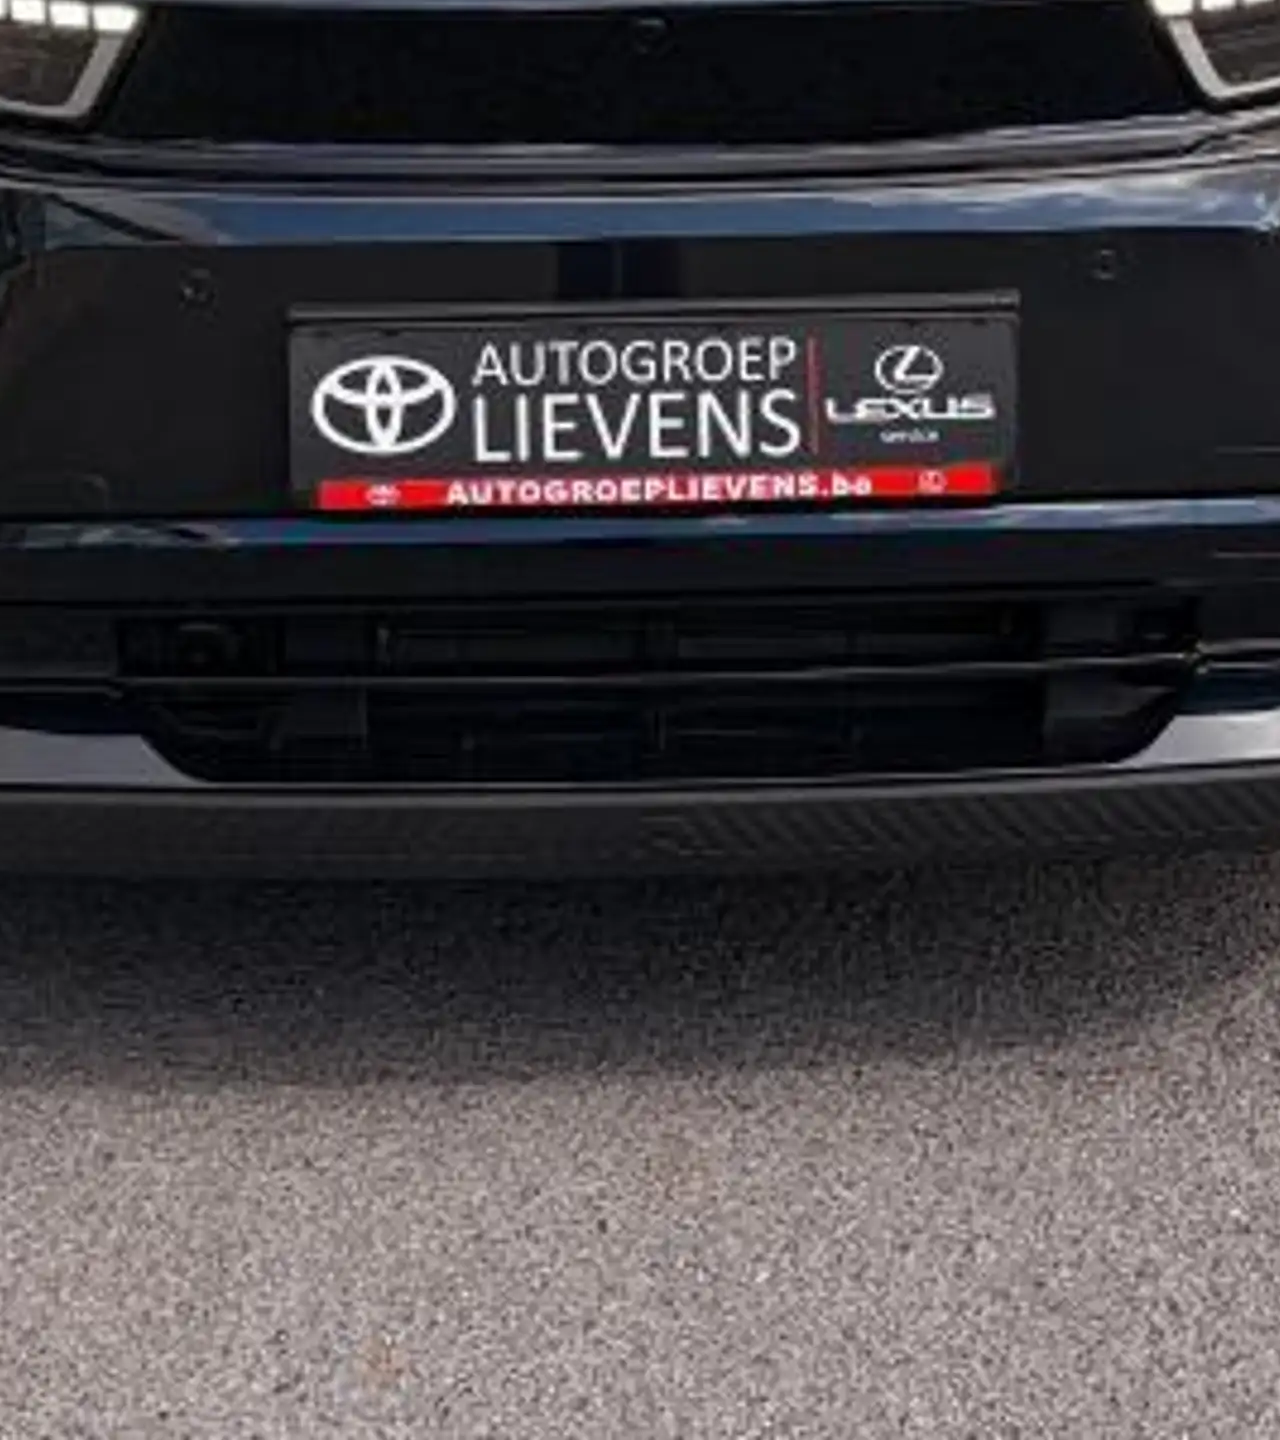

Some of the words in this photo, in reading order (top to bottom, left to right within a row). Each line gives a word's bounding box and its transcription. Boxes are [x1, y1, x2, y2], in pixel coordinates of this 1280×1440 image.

[472, 336, 797, 387] AUTOGROEP
[474, 388, 801, 462] LIEVENS
[825, 393, 996, 425] LEXUS
